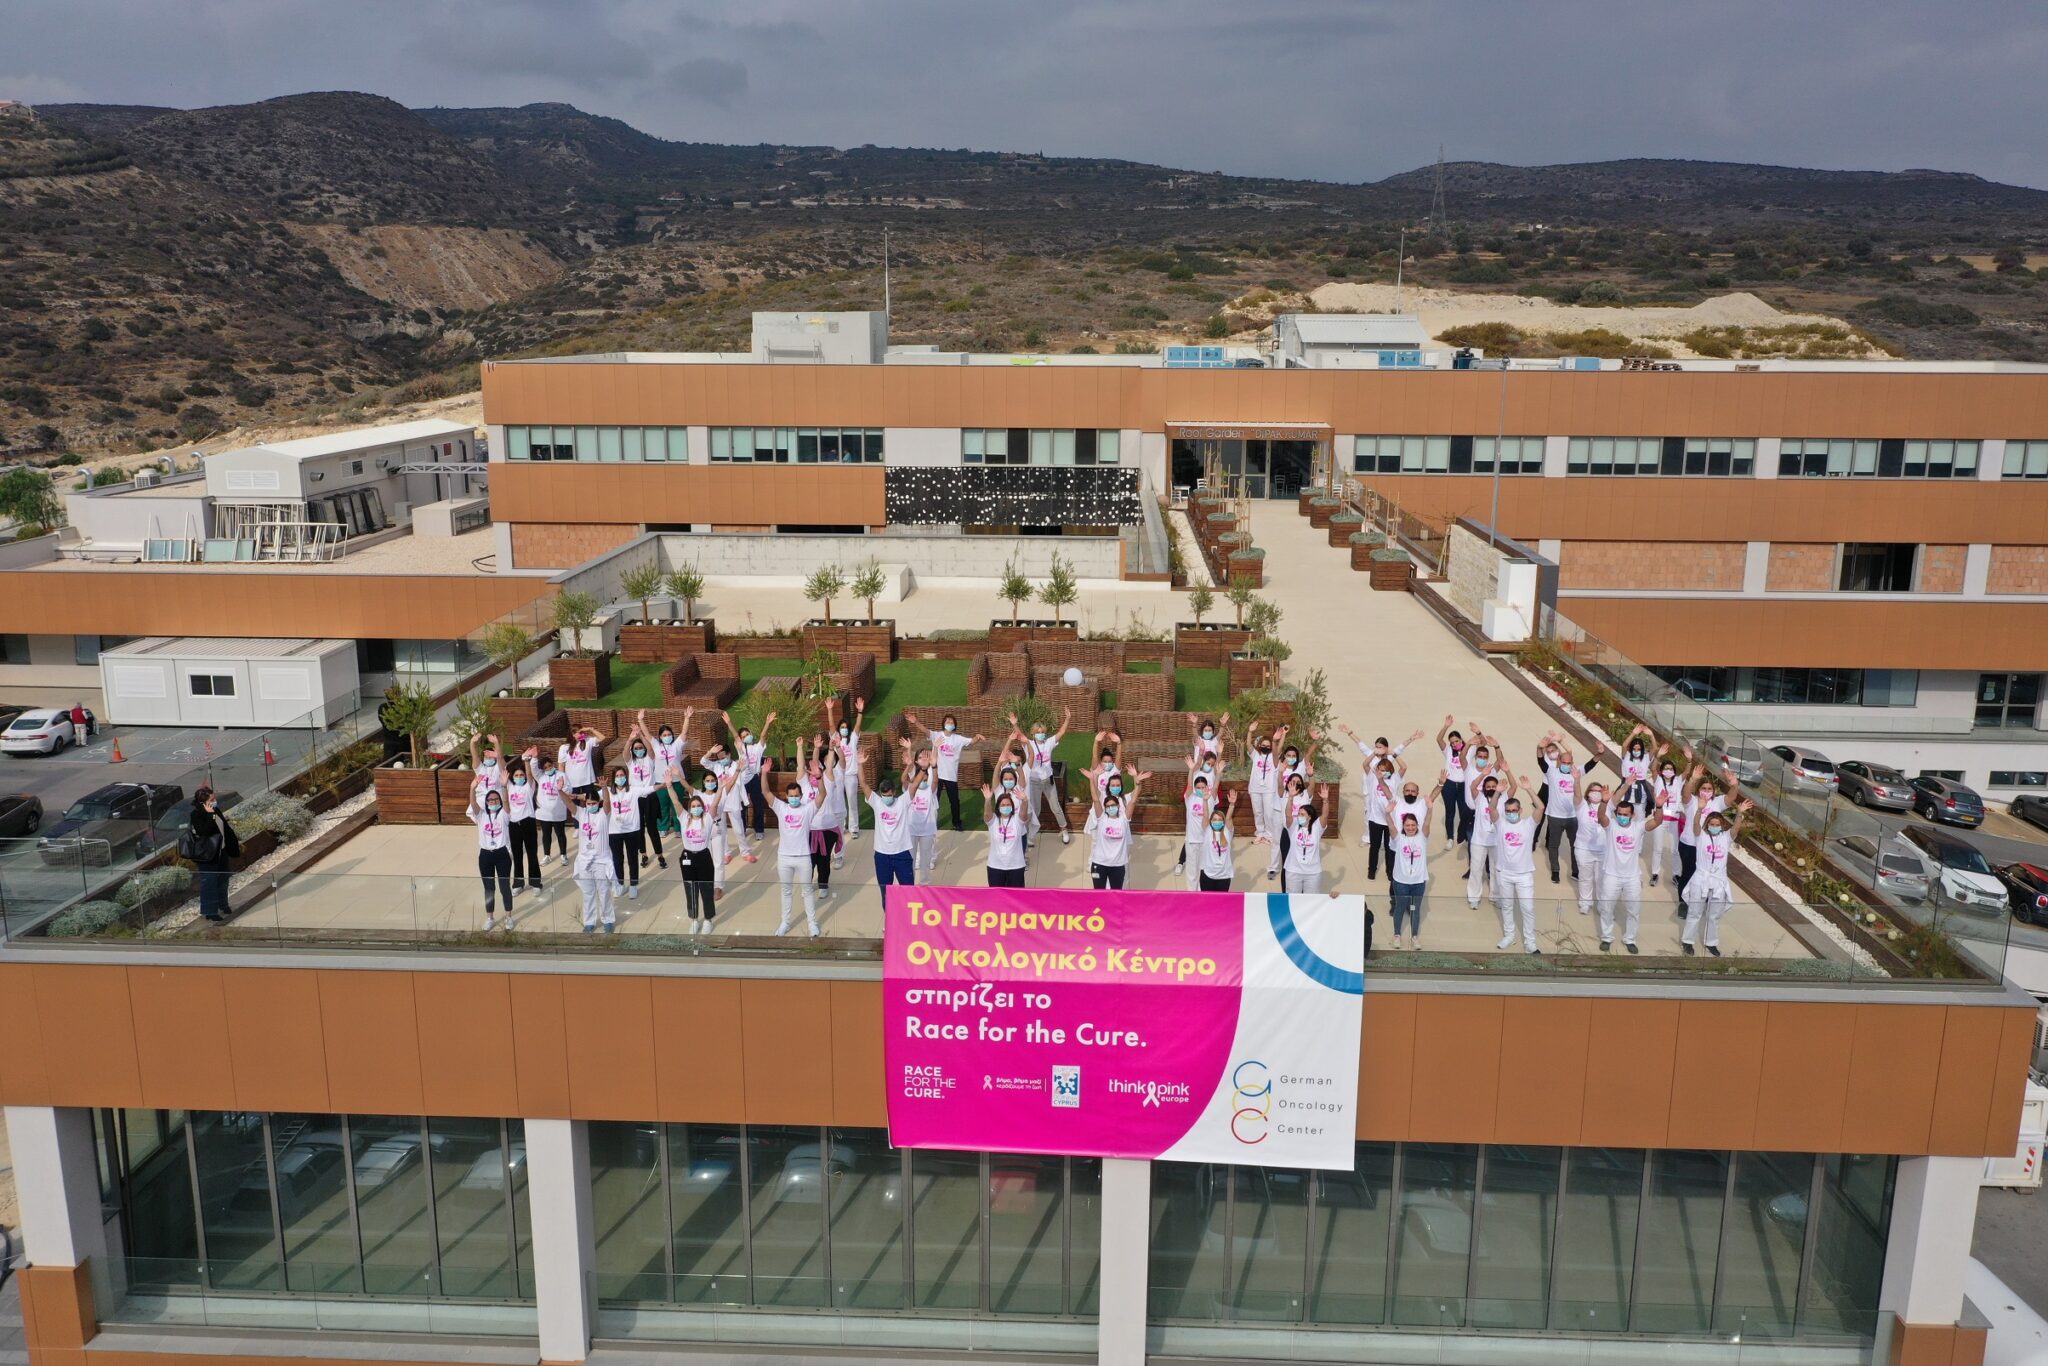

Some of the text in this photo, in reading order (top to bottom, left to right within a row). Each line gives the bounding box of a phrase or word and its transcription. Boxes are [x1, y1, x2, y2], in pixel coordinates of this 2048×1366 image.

[907, 901, 1105, 936] Το Γερμανικό
[906, 940, 1216, 981] Ογκολογικό Κέντρο
[905, 983, 1051, 1012] στηρίζει το
[906, 1016, 1147, 1048] Race for the Cure.
[904, 1065, 942, 1077] RACE
[904, 1076, 957, 1089] FOR THE
[1279, 1075, 1332, 1086] German
[904, 1087, 945, 1099] CURE.
[1108, 1078, 1190, 1098] think pink
[1053, 1099, 1078, 1107] CYPRUS
[1160, 1095, 1190, 1104] europe
[1278, 1099, 1344, 1112] Oncology
[1277, 1124, 1324, 1136] Center
